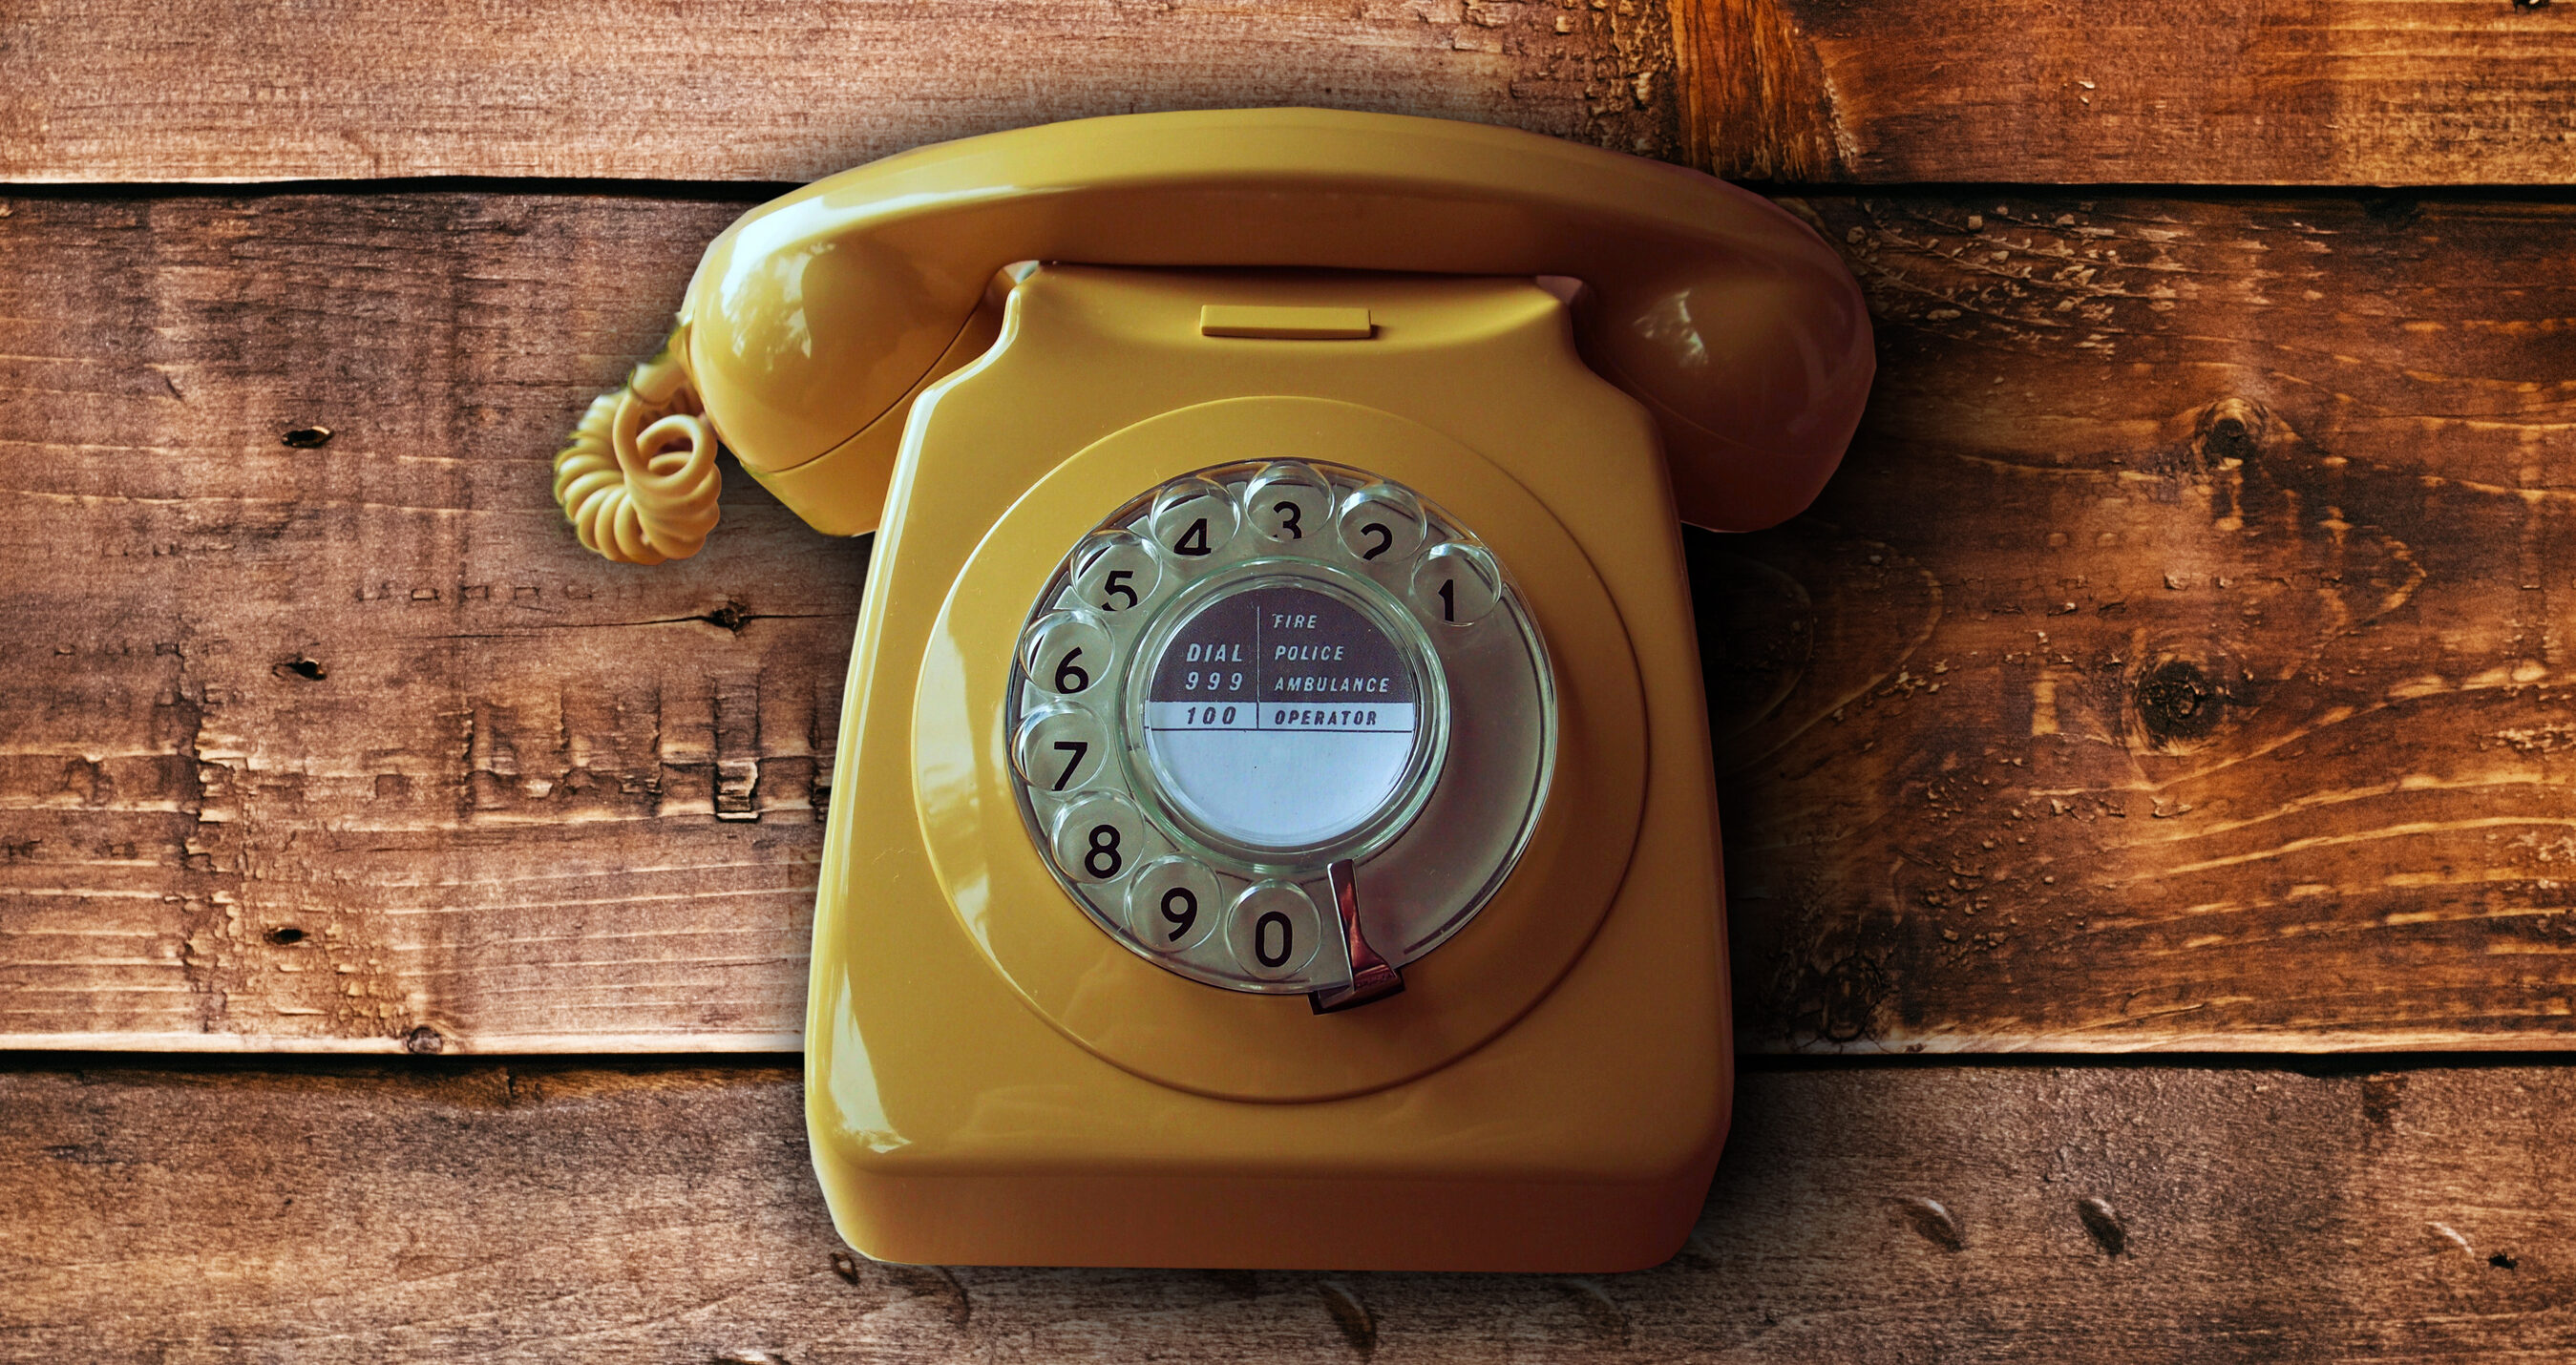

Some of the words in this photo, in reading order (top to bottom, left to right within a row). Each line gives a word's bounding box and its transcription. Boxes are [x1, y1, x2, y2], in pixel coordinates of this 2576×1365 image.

[1173, 518, 1212, 556] 4
[1273, 501, 1302, 539] 3
[1102, 570, 1138, 611] 5
[1438, 579, 1454, 621] 1
[1272, 614, 1317, 629] FIRE
[1054, 647, 1088, 694] 6
[1187, 643, 1242, 662] DIAL
[1275, 645, 1344, 662] POLICE
[1274, 677, 1390, 693] AMBULANCE
[1275, 710, 1378, 725] OPERATOR
[1051, 742, 1087, 791] 7
[1085, 825, 1122, 878] 8
[1161, 888, 1197, 942] 9
[1256, 912, 1292, 967] 0
